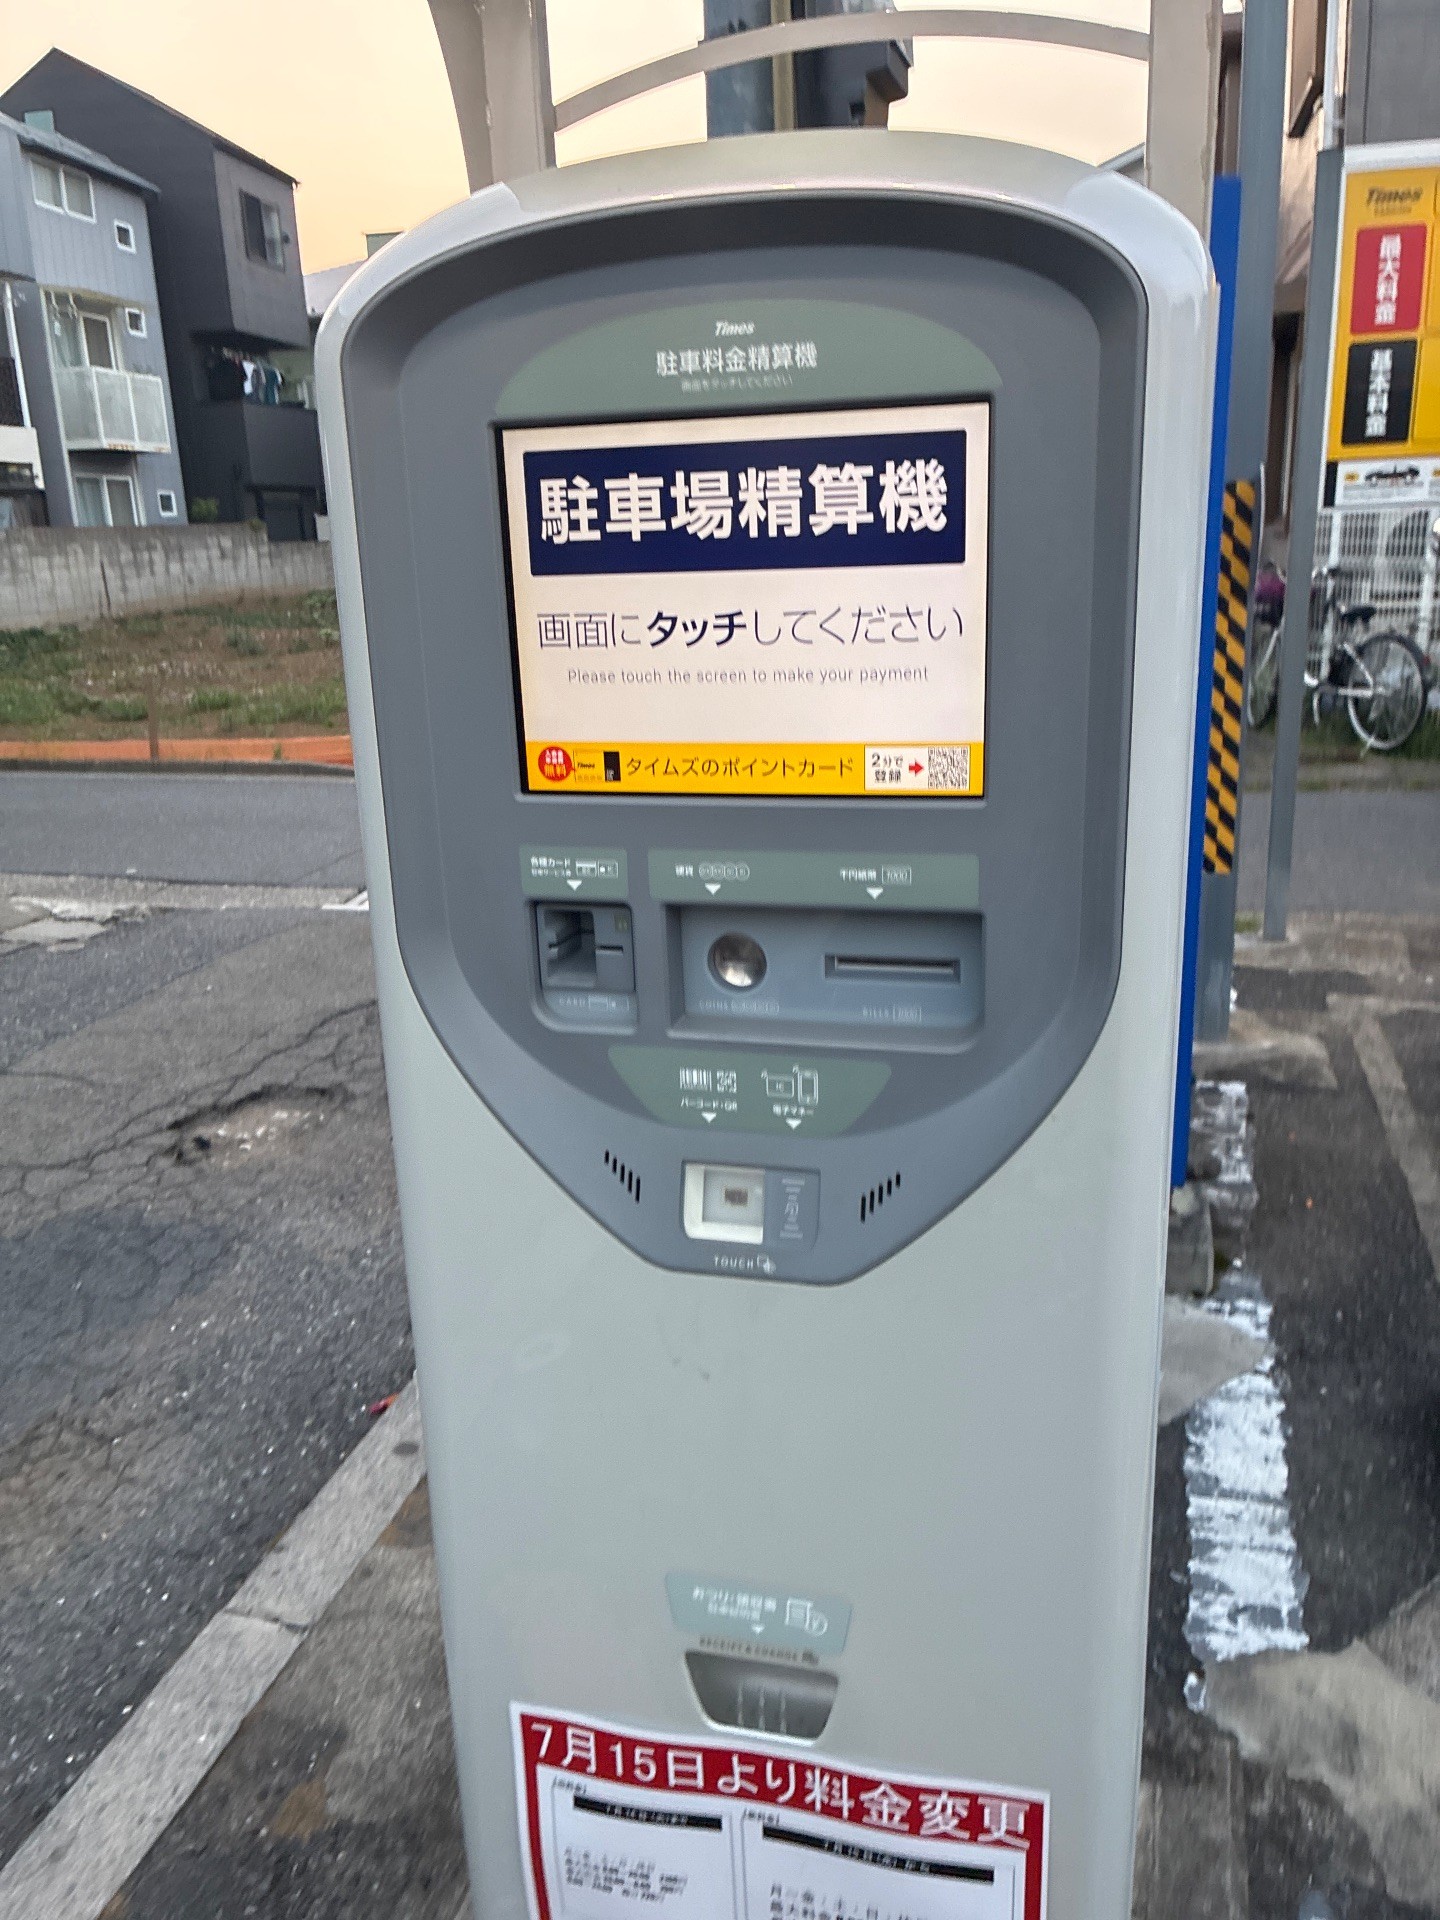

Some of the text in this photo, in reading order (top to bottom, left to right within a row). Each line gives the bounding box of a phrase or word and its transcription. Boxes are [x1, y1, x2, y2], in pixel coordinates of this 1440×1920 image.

[715, 320, 756, 337] Times
[656, 339, 818, 377] 駐車料金精算機
[539, 458, 948, 545] 駐車場精算機
[537, 605, 964, 649] 画面にタッチしてください
[568, 666, 929, 686] Please touch the screen to make your payment
[626, 756, 855, 778] タイムズのポイントカード
[530, 1723, 1032, 1849] 7月15日より料金変更
